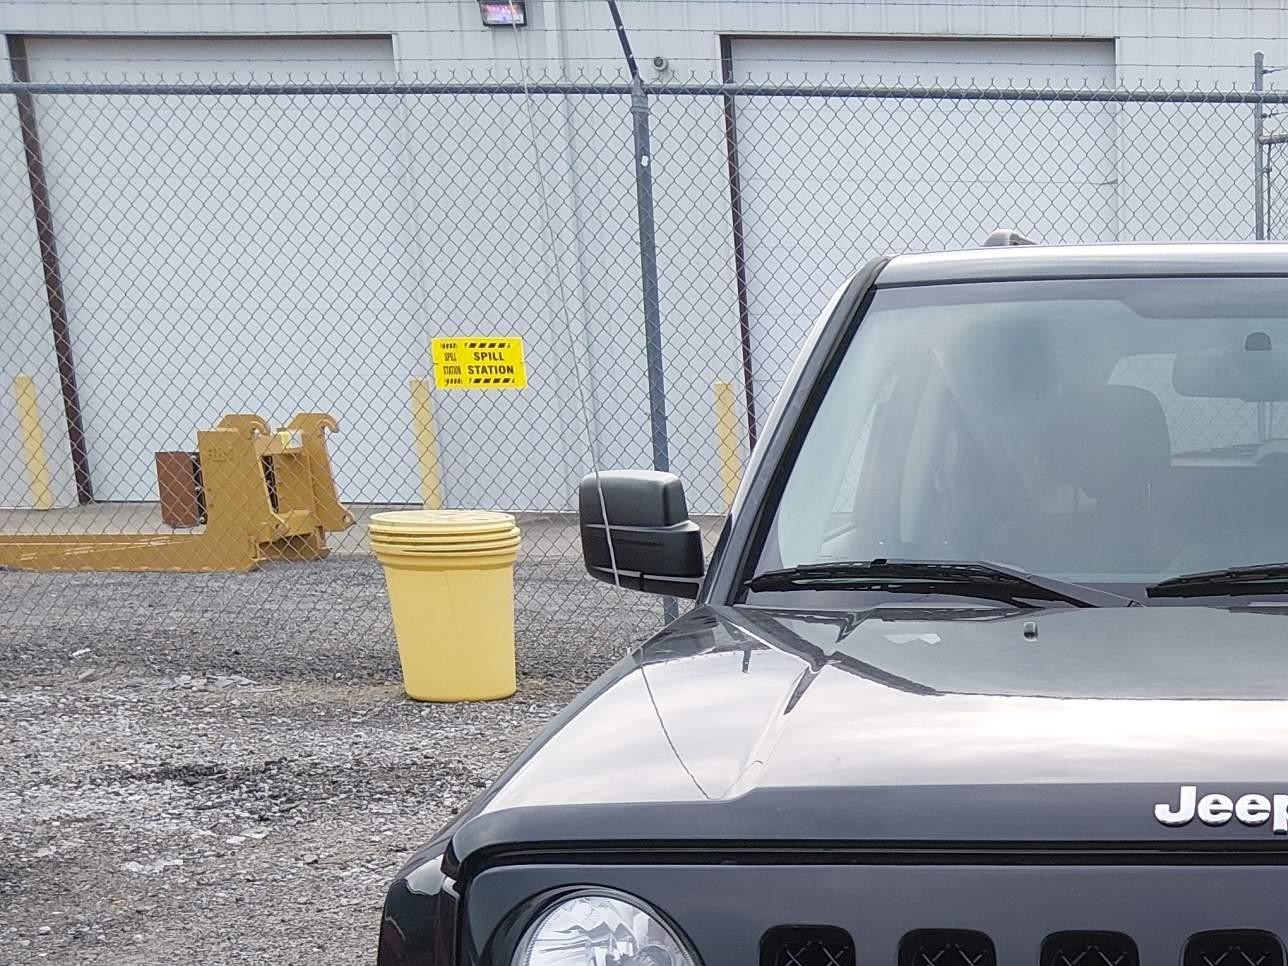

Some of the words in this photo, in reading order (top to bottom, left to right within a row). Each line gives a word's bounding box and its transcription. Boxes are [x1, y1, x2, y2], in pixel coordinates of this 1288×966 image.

[445, 353, 457, 361] SPILL
[474, 352, 504, 361] SPILL
[443, 366, 461, 375] STATION
[467, 365, 514, 375] STATION
